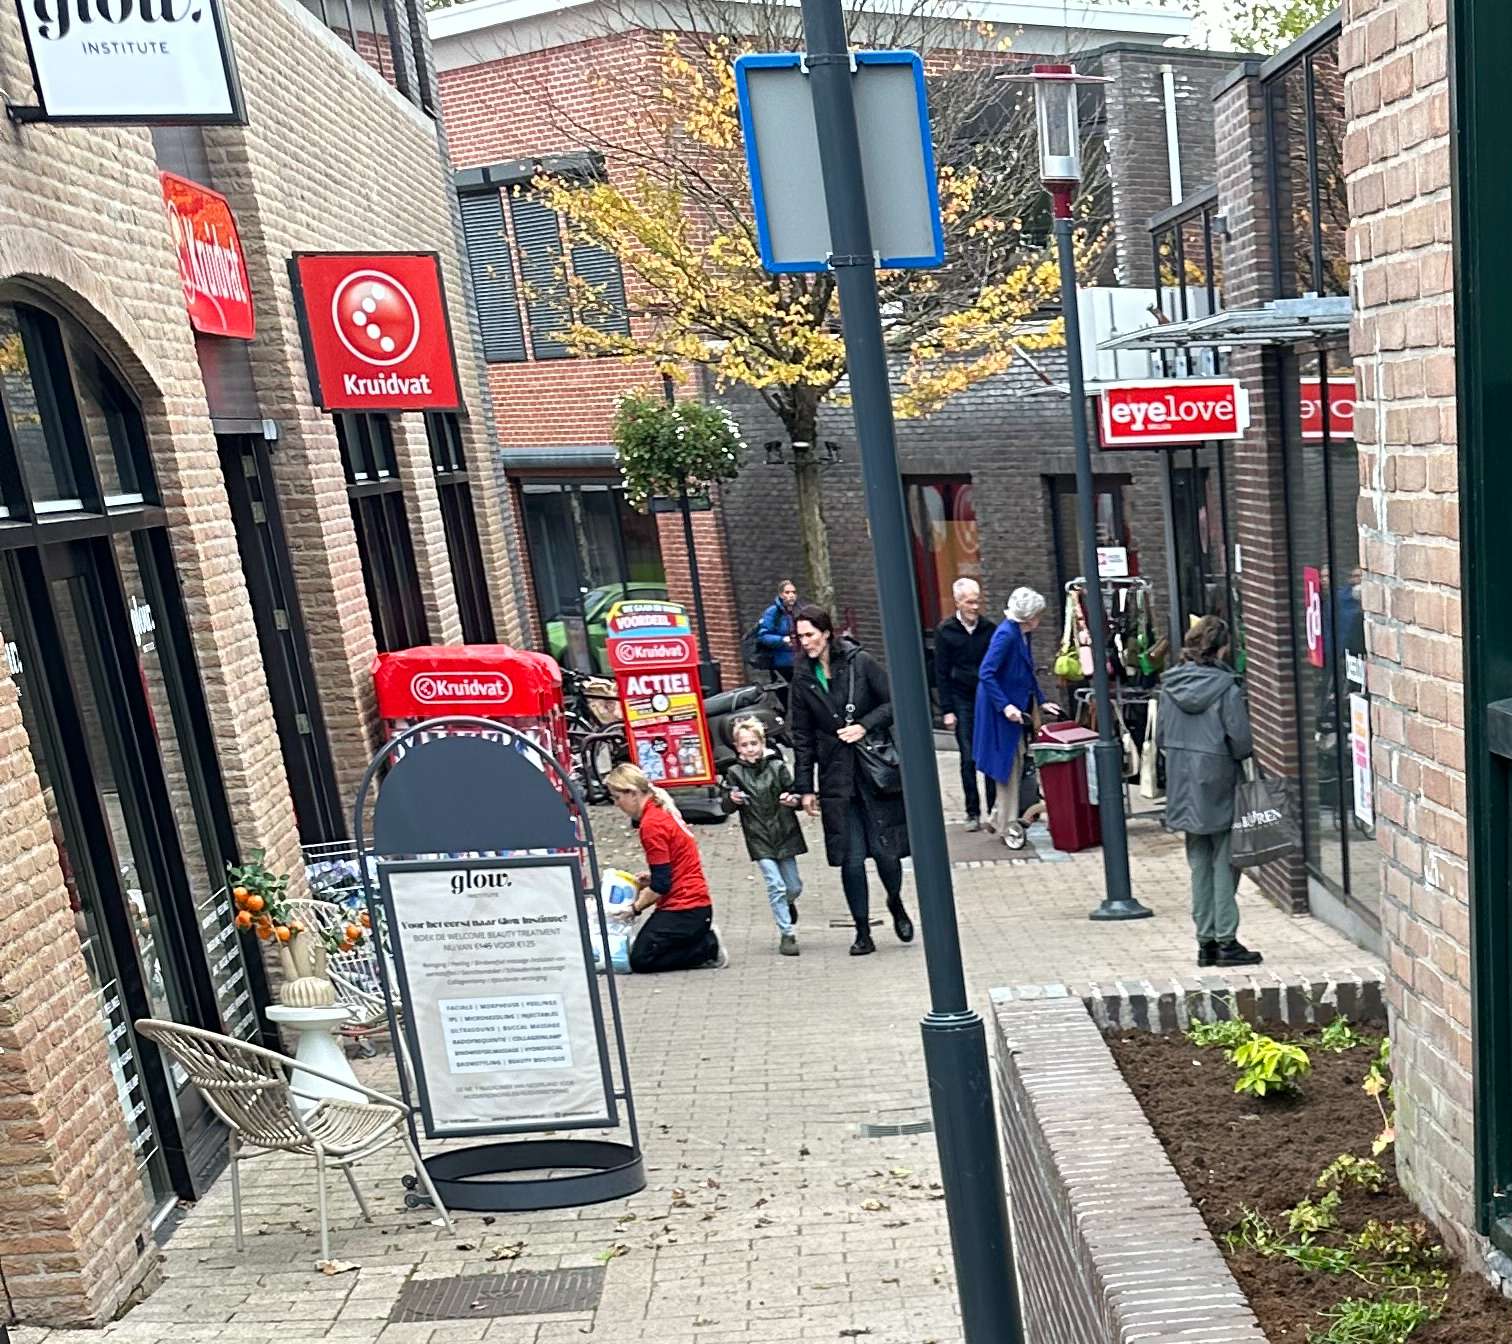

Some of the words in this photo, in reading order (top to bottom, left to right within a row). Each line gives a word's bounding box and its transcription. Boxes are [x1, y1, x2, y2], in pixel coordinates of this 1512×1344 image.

[81, 41, 170, 55] INSTITUTE
[343, 372, 433, 395] Kruidvat
[1111, 395, 1234, 431] eyelove
[635, 645, 684, 660] Kruidvat
[436, 678, 505, 697] Kruidvat
[626, 672, 691, 696] ACTIE!
[450, 869, 513, 895] glow.
